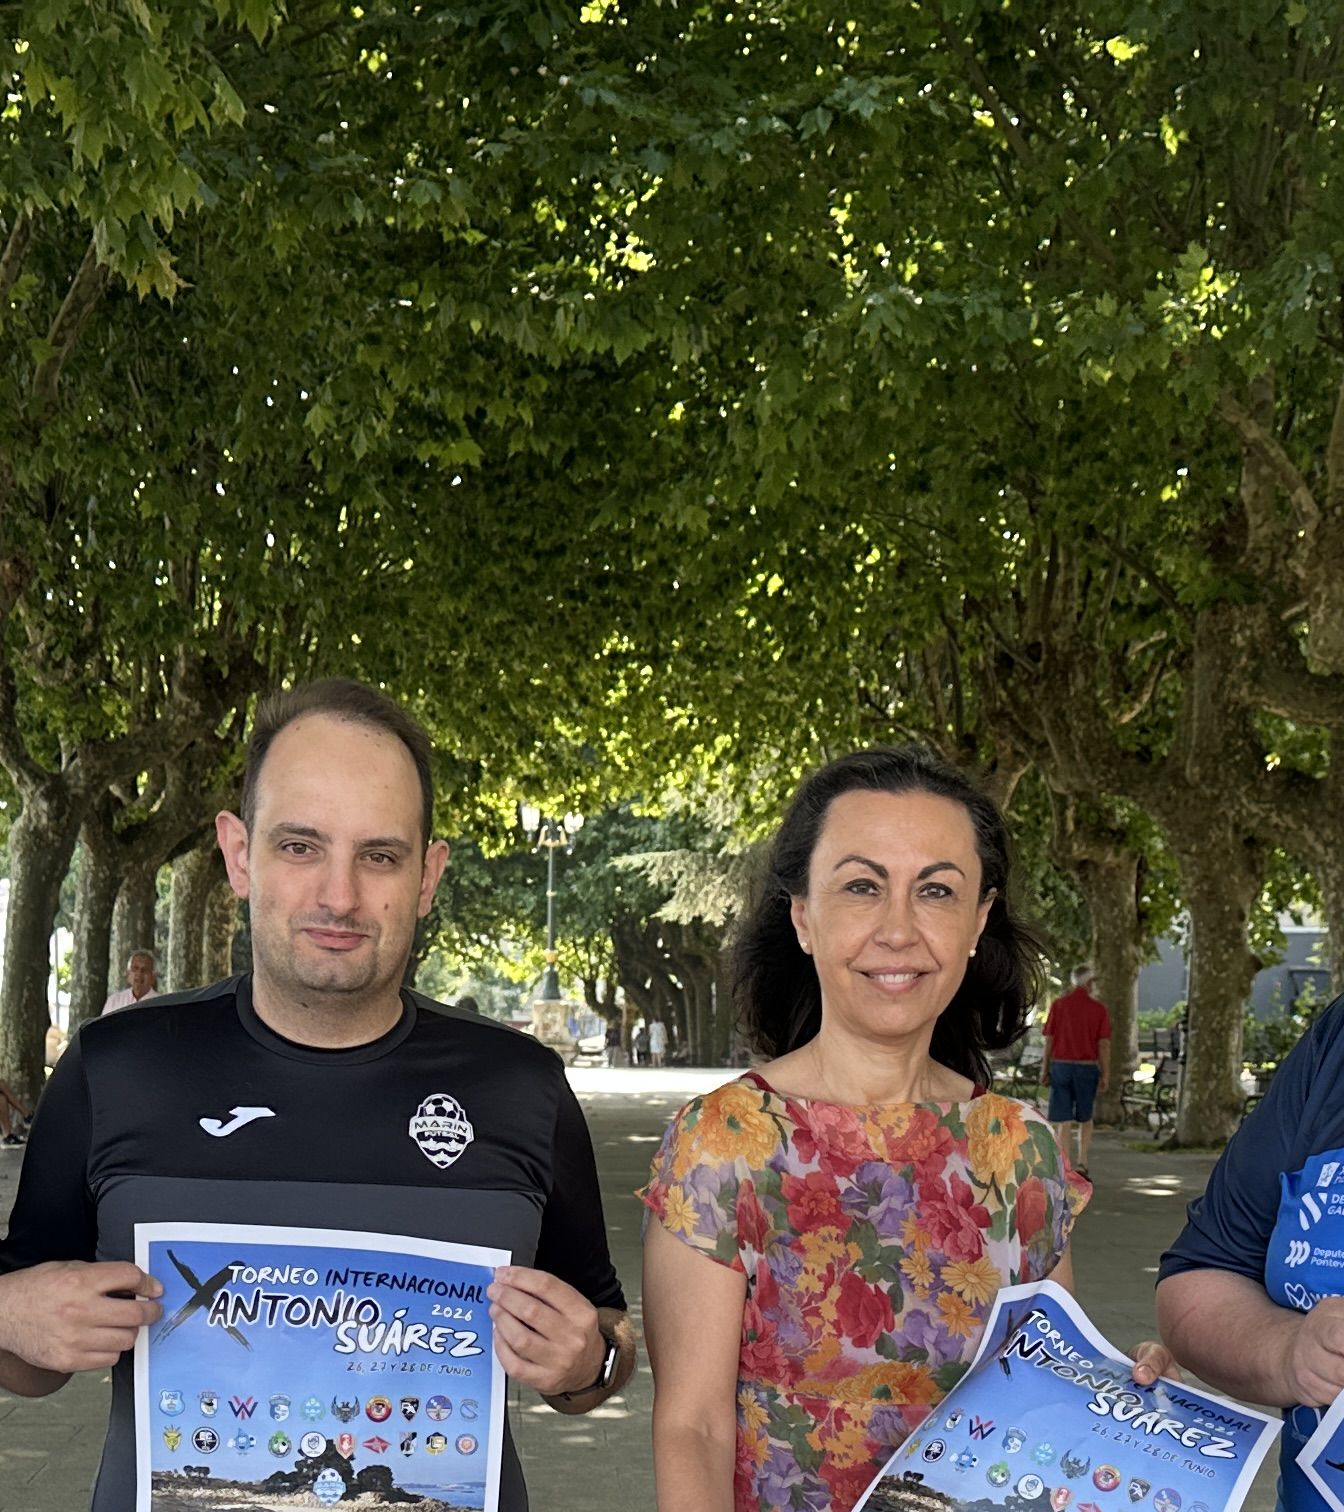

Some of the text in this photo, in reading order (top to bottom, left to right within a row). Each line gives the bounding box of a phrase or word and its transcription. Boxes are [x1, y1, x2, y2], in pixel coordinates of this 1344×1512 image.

[227, 1264, 484, 1303] TORNEO INTERNACIONAL
[207, 1287, 382, 1329] ANTONIO
[431, 1304, 473, 1322] 2026
[333, 1307, 485, 1358] SUÁREZ
[370, 1361, 387, 1373] 27
[400, 1362, 415, 1373] 28
[419, 1363, 432, 1373] DE
[438, 1364, 472, 1377] JUNIO
[1001, 1329, 1144, 1407] NTONIO
[1027, 1310, 1253, 1433] TORNEO INNACIONAL
[1086, 1392, 1238, 1460] SUÁREZ
[1192, 1417, 1236, 1437] 2026
[1113, 1432, 1131, 1445] 27
[1143, 1444, 1159, 1457] 28
[1162, 1451, 1178, 1463] DE
[1182, 1458, 1216, 1479] JUNIO
